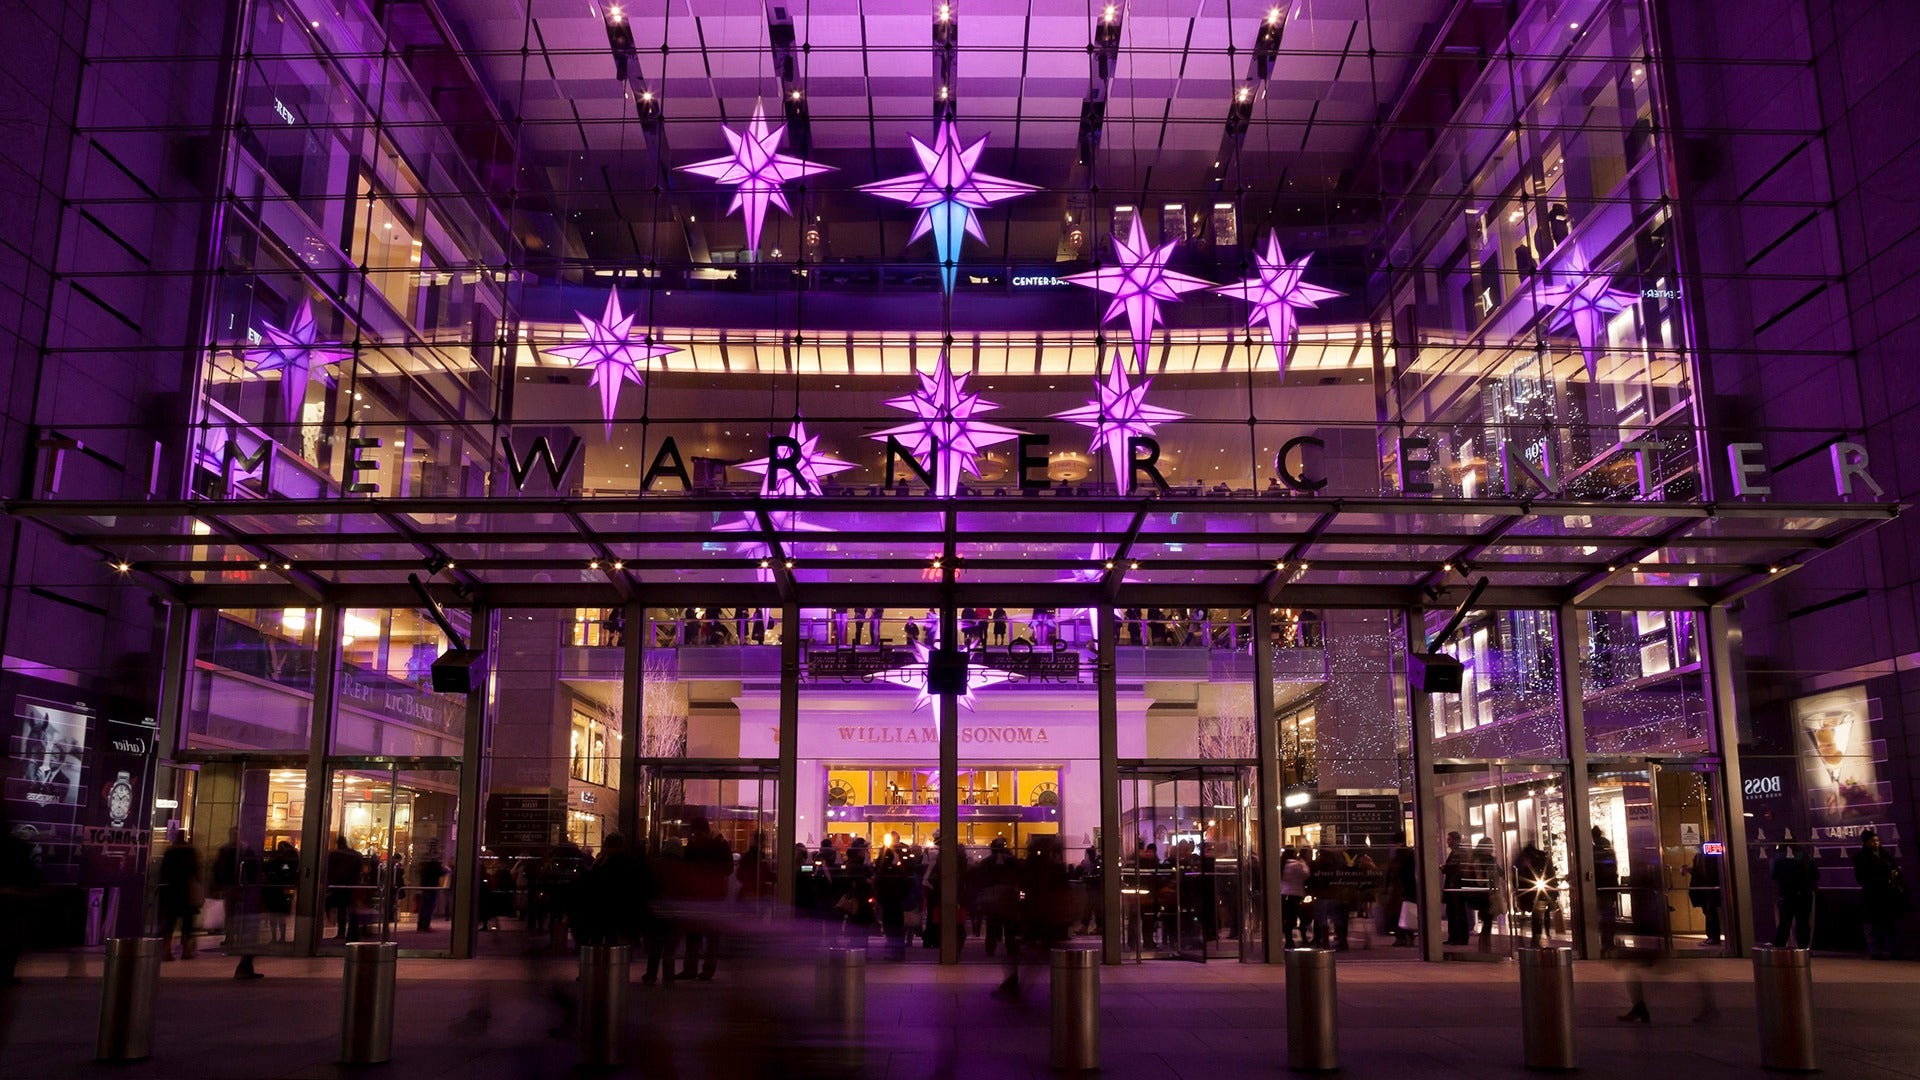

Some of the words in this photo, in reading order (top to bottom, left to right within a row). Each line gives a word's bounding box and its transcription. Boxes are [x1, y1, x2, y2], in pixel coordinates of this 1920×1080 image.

[34, 437, 382, 494] TIME
[501, 435, 1170, 490] WARNER
[1274, 436, 1885, 497] CENTER
[799, 638, 893, 664] THE
[933, 637, 1099, 664] HOPS
[841, 669, 988, 684] COLUS
[343, 672, 403, 713] REPLIC
[405, 694, 433, 722] BANK
[961, 726, 1050, 743] SONOMA
